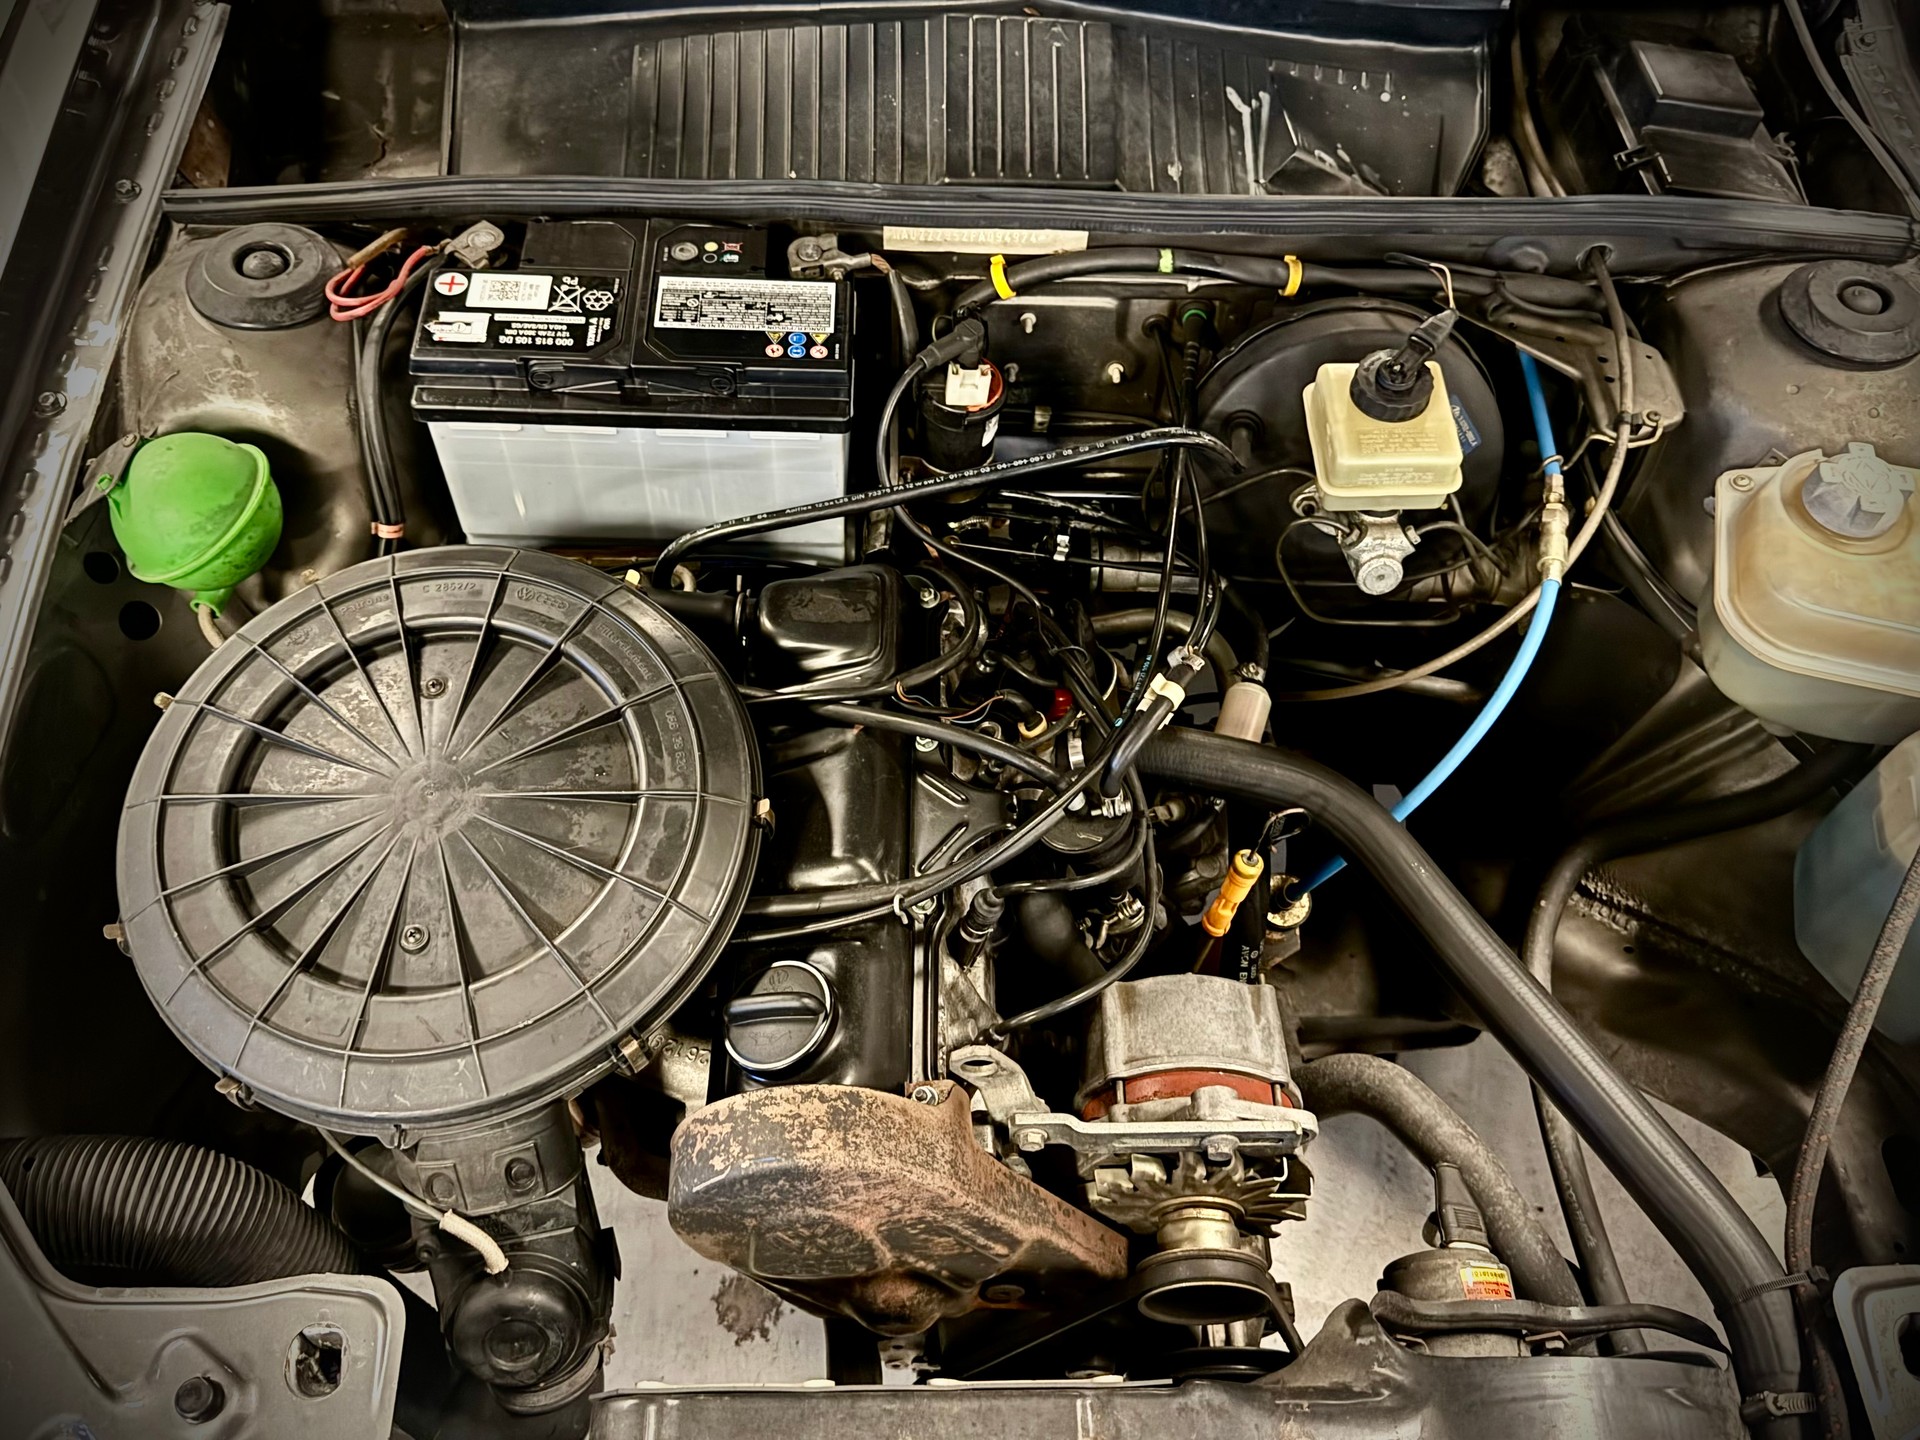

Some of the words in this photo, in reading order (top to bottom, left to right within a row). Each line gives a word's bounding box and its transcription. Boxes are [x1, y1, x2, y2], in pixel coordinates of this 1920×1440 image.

[562, 276, 578, 285] Pb
[515, 335, 532, 344] 105
[535, 336, 553, 345] 915
[555, 337, 574, 346] 000
